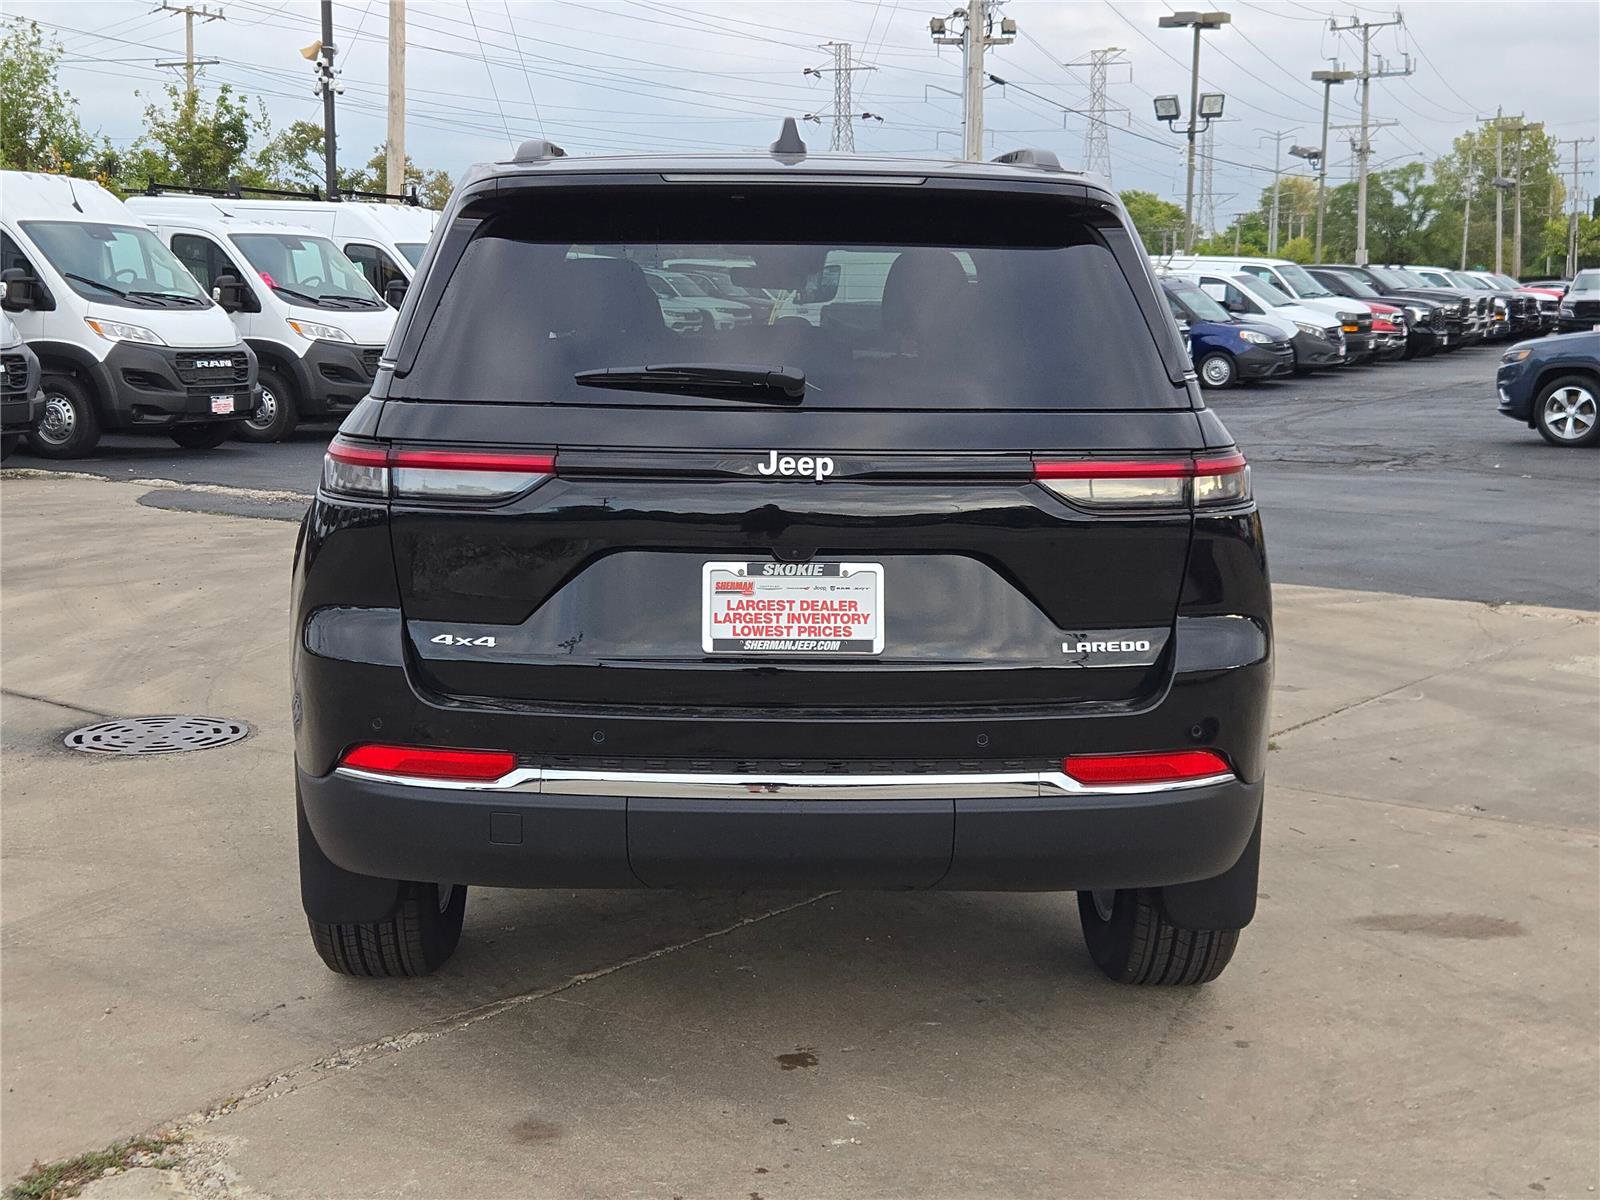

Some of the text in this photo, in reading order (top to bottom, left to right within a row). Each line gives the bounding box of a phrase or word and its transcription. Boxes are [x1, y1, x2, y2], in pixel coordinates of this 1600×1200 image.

[196, 360, 232, 368] RAM
[757, 450, 834, 481] Jeep
[762, 563, 825, 577] SKOKIE
[715, 581, 754, 591] SHERMAN
[726, 600, 858, 612] LARGEST DEALER
[713, 612, 870, 625] LARGEST INVENTORY
[732, 625, 853, 638] LOWEST PRICES
[430, 634, 497, 648] 4x4
[743, 639, 841, 651] SHERMANJEEP.COM
[1062, 640, 1150, 653] LAREDO
